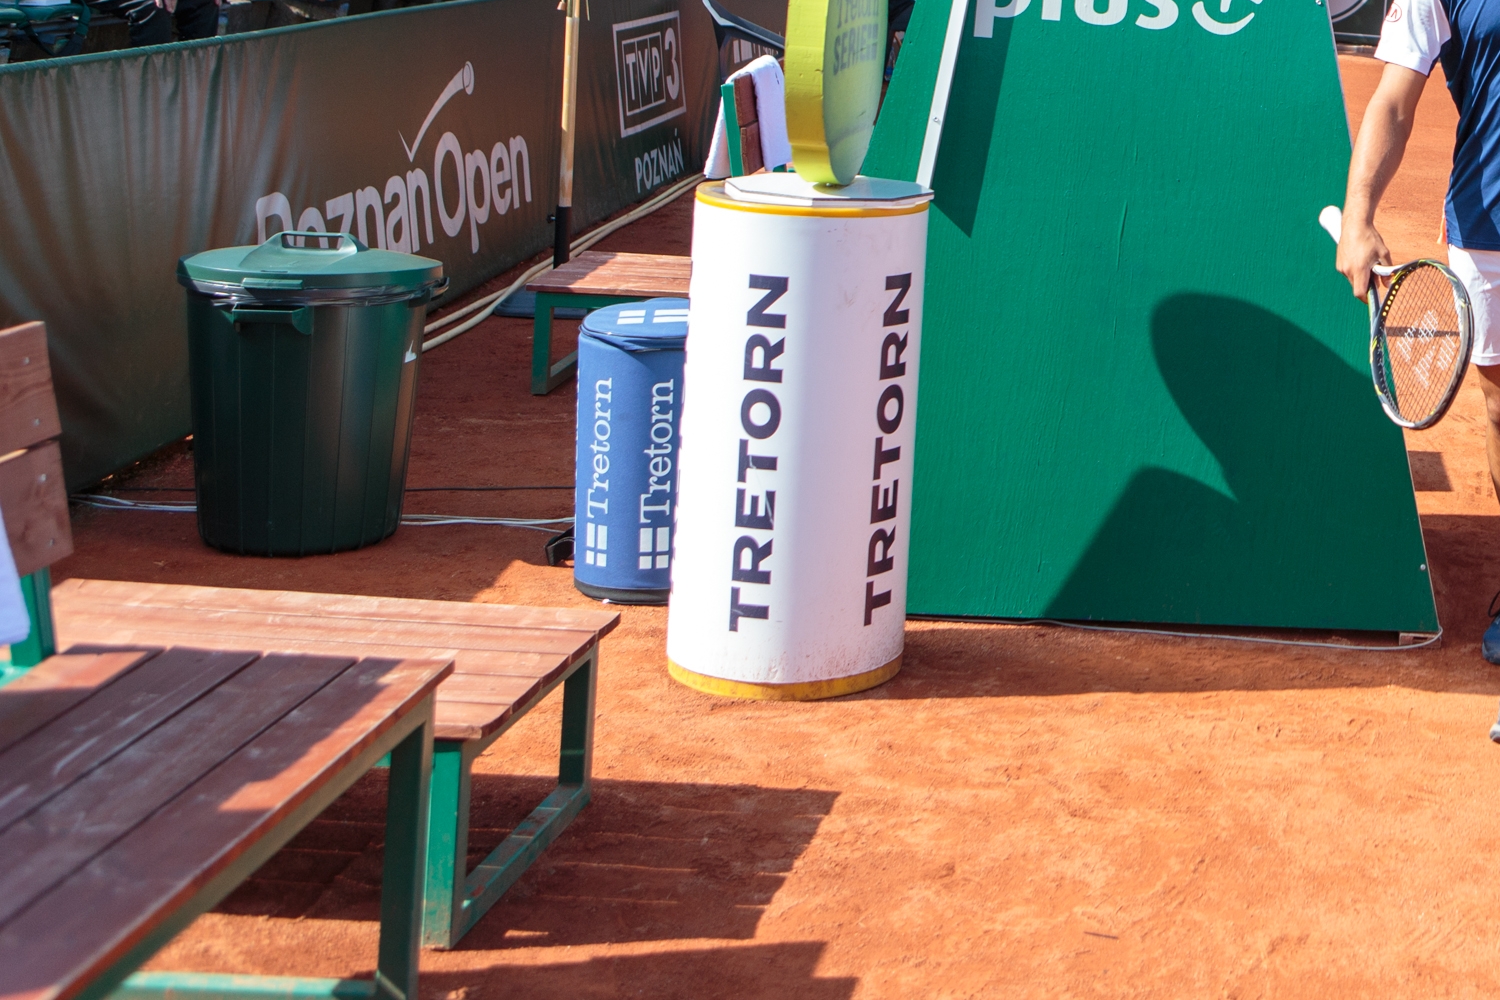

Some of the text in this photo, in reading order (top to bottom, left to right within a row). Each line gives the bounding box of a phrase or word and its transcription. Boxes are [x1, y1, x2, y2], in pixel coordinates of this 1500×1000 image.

[626, 27, 680, 100] TVP 3
[434, 131, 532, 254] Open
[634, 128, 685, 194] POZNAŃ
[586, 377, 613, 519] Tretorn
[640, 378, 675, 524] Tretorn
[728, 273, 790, 633] TRETORN
[863, 271, 912, 627] TRETORN
